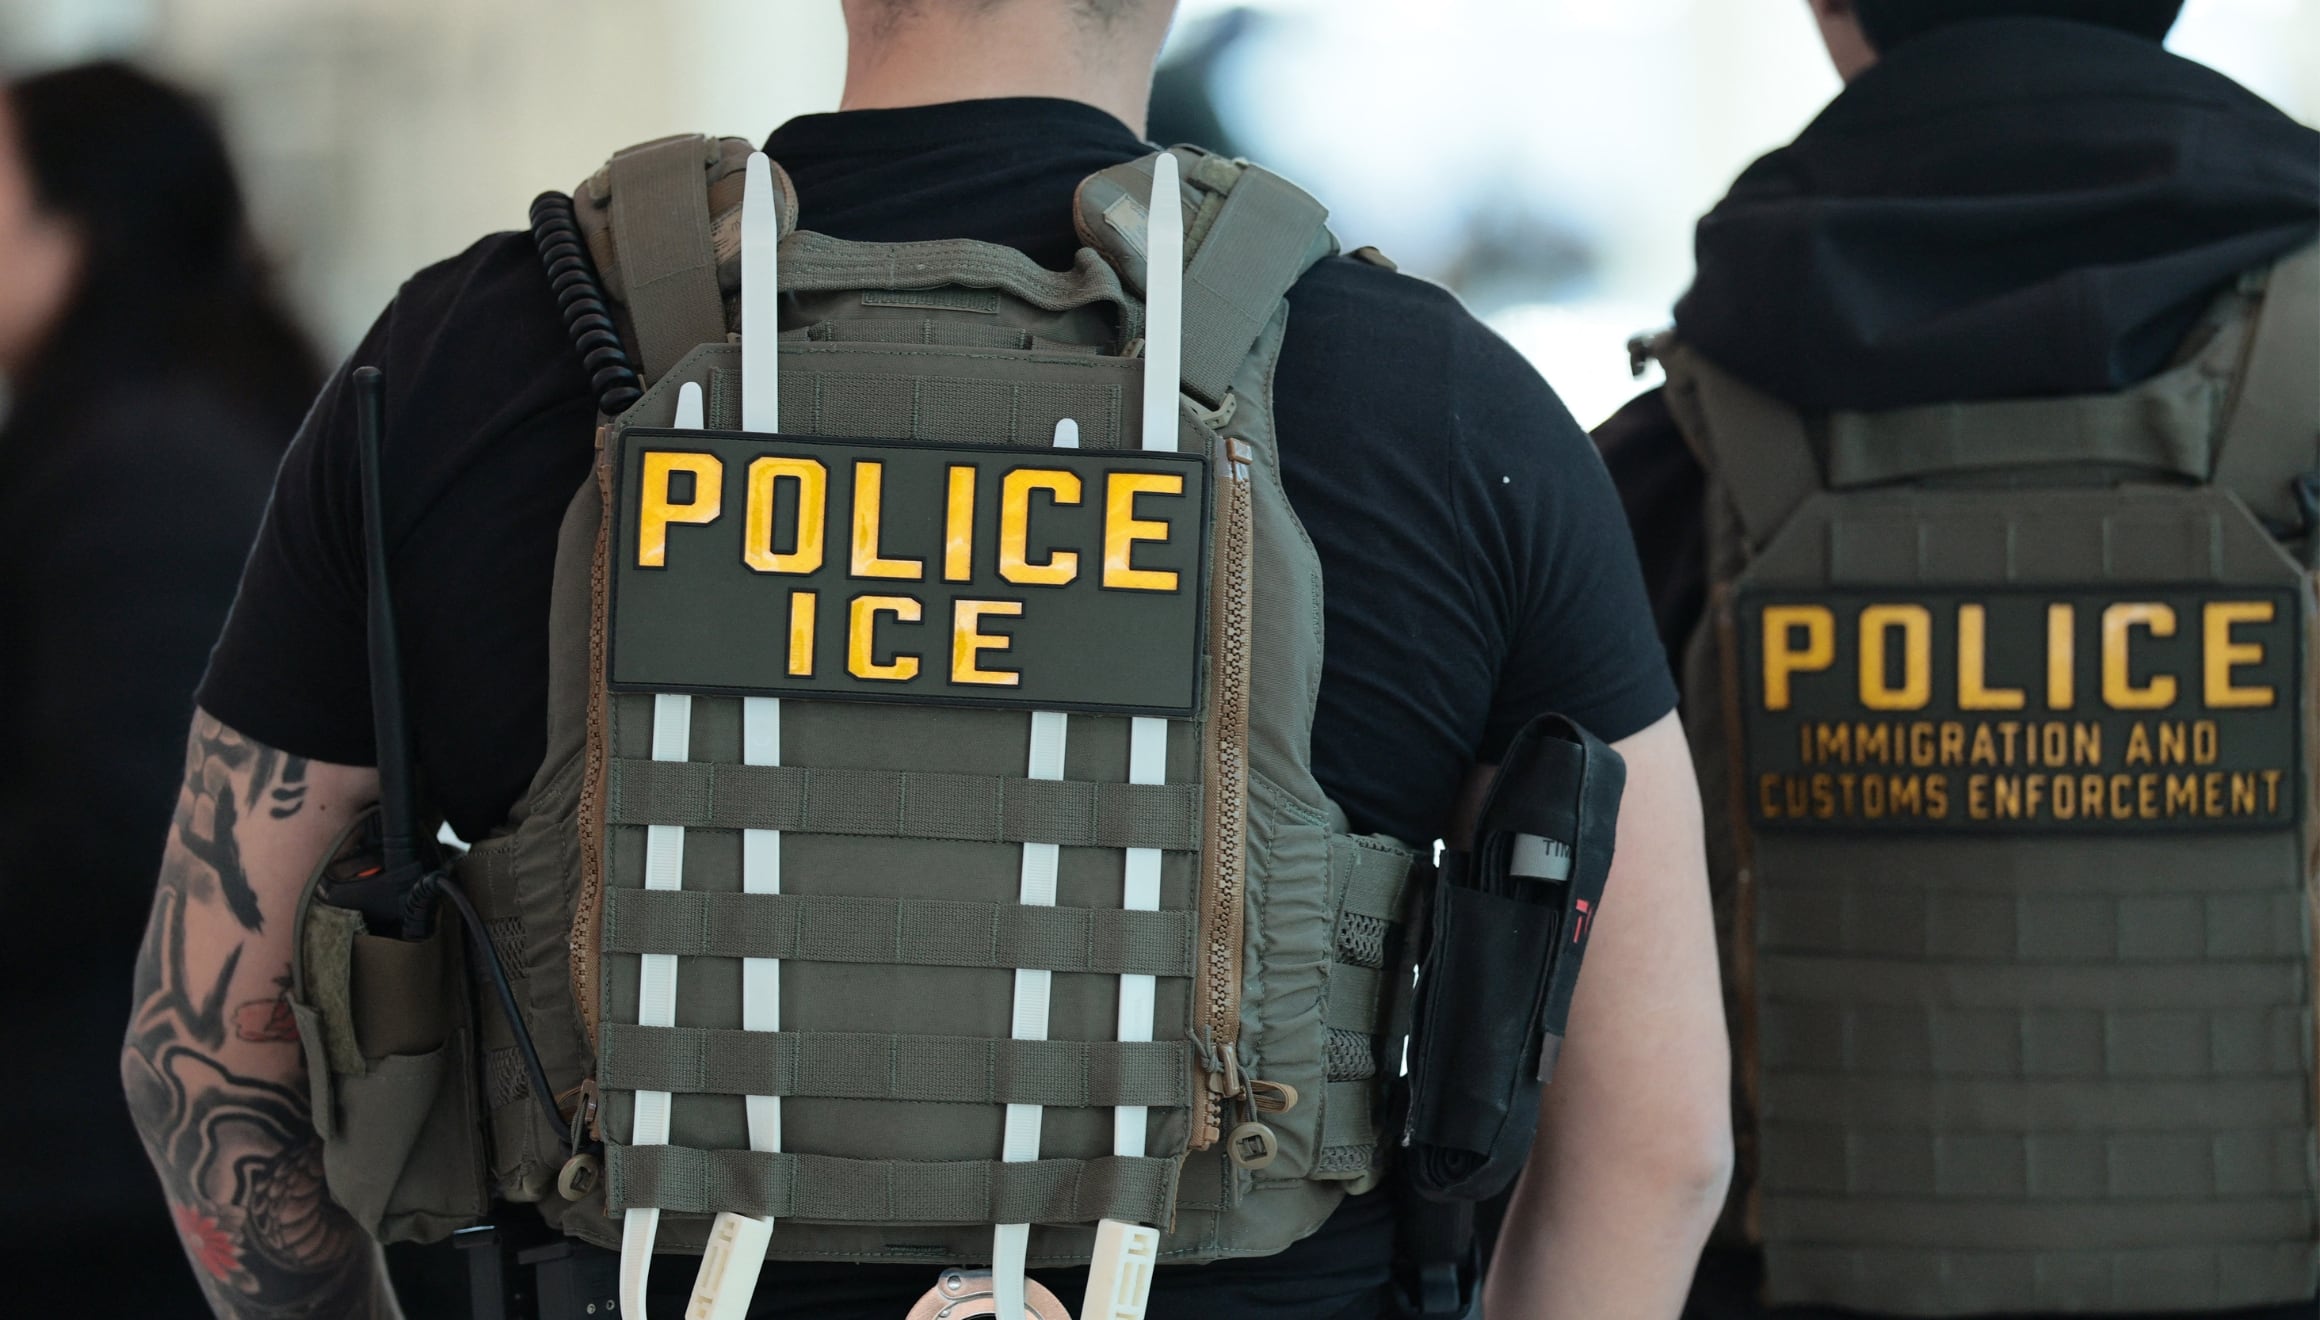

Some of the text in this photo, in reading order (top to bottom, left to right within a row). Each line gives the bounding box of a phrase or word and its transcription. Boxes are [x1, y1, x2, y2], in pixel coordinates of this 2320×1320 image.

[637, 450, 1184, 591] POLICE
[786, 590, 1024, 686] ICE
[1762, 602, 2276, 710] POLICE
[1801, 719, 2219, 767] IMMIGRATION AND
[1759, 770, 2283, 820] CUSTOMS ENFORCEMENT
